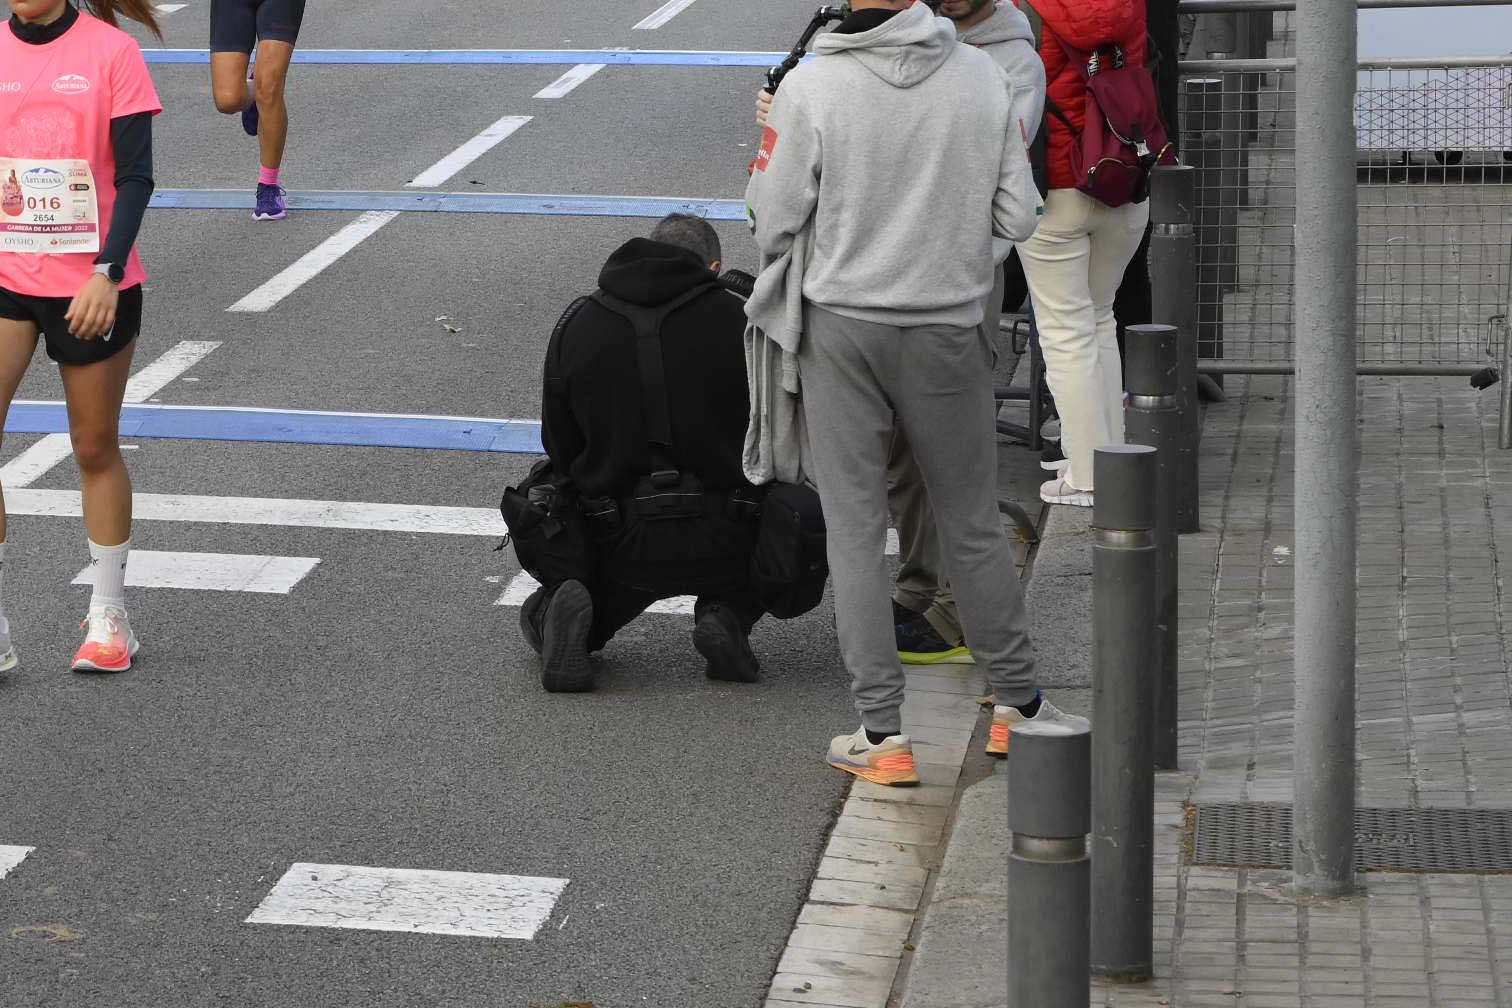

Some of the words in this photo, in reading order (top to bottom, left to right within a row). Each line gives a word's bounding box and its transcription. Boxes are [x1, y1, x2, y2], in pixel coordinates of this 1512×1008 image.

[24, 175, 62, 184] ASTURIANA
[27, 196, 61, 210] 016
[33, 214, 55, 222] 2654
[51, 224, 72, 232] MUJER
